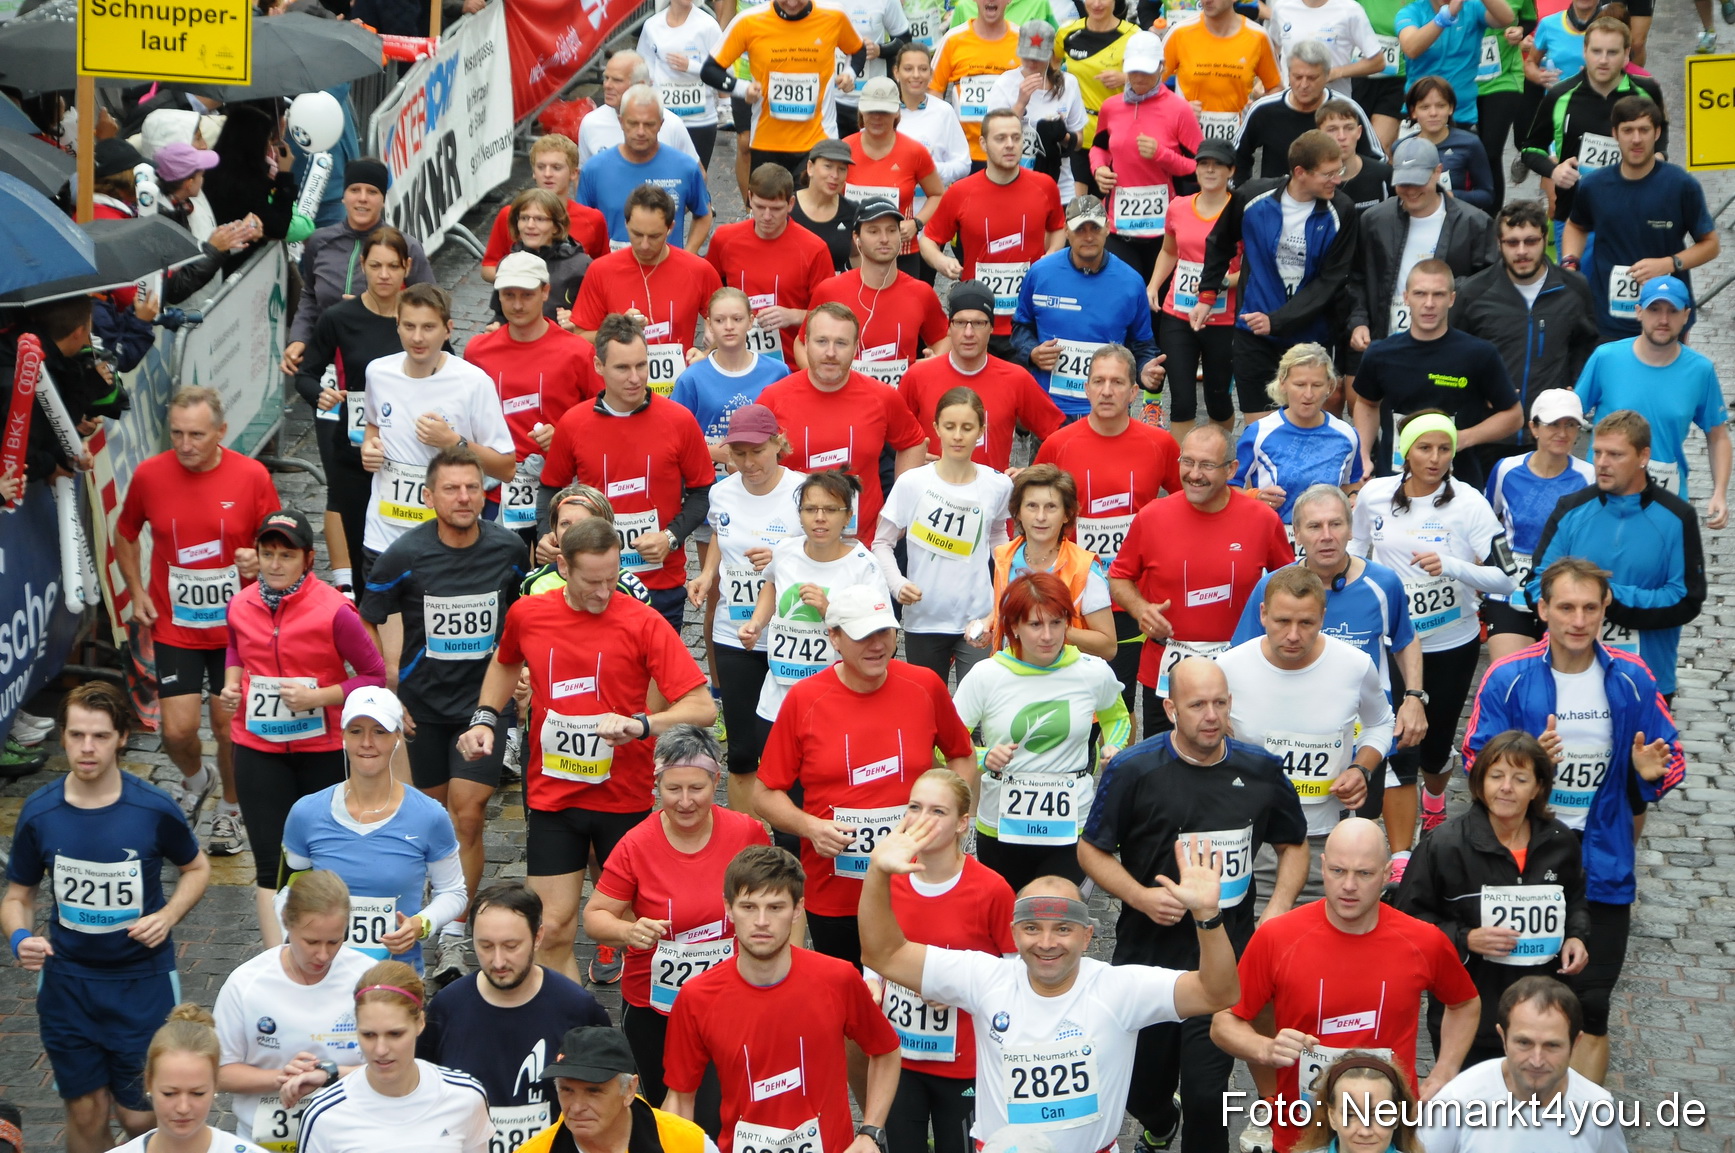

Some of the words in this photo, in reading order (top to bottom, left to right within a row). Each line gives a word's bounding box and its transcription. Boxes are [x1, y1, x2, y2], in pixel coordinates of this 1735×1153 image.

[90, 0, 237, 27] Schnupper-
[911, 21, 928, 37] 86
[141, 29, 188, 52] lauf
[1069, 48, 1088, 59] Birgit
[662, 88, 701, 105] 2860
[773, 84, 813, 102] 2981
[965, 86, 986, 104] 29
[778, 104, 808, 114] Christian
[1585, 147, 1622, 166] 248
[1120, 199, 1164, 216] 2223
[1128, 220, 1154, 229] Andrea
[994, 299, 1017, 308] ichael
[870, 348, 887, 358] DEHN
[649, 358, 675, 380] 09
[871, 365, 900, 373] Neumarkt
[1058, 353, 1091, 375] 248
[512, 399, 530, 409] DEHN
[6, 410, 28, 449] BKK
[819, 454, 837, 463] DEHN
[617, 482, 635, 492] DEHN
[925, 488, 945, 504] PARTL
[944, 499, 972, 513] Neumarkt
[1101, 498, 1120, 508] DEHN
[392, 506, 424, 520] Markus
[614, 517, 647, 527] Neumarkt
[928, 507, 966, 537] 411
[1078, 522, 1100, 532] PARTL
[1100, 522, 1132, 531] Neumark
[926, 531, 954, 551] Nicole
[171, 571, 193, 581] PARTL
[193, 571, 227, 582] Neumarkt
[726, 569, 743, 577] PARTL
[1415, 577, 1447, 590] Neumarkt
[177, 582, 235, 606] 2006
[1199, 590, 1219, 601] DEHN
[425, 602, 450, 610] PARTL
[451, 600, 487, 610] Neumarkt
[192, 610, 219, 621] Josef
[432, 609, 492, 636] 2589
[770, 622, 788, 632] PARTL
[788, 627, 821, 635] Neumarkt
[1414, 614, 1446, 631] Kerstin
[444, 641, 481, 651] Norbert
[773, 633, 828, 662] 2742
[780, 665, 817, 678] Cornelia
[250, 682, 269, 690] PARTL
[565, 681, 585, 693] DEHN
[261, 721, 309, 735] Sieglinde
[546, 717, 565, 730] PARTL
[566, 722, 599, 731] Neumark
[555, 730, 601, 758] 207
[1266, 738, 1293, 748] PARTL
[1294, 740, 1332, 749] Neumarkt
[1567, 750, 1604, 760] Neumarkt
[559, 758, 599, 774] Michael
[1282, 750, 1330, 777] 442
[865, 764, 887, 777] DEHN
[1559, 761, 1607, 788] 452
[1003, 778, 1029, 787] PARTL
[1029, 780, 1064, 788] Neumarkt
[1295, 783, 1321, 795] effen
[1007, 789, 1071, 817] 2746
[1554, 793, 1590, 805] Hubert
[835, 814, 862, 824] PARTL
[864, 813, 901, 824] Neumarkt
[1026, 824, 1048, 835] Inka
[1211, 837, 1247, 847] Neumarkt
[56, 863, 82, 875] PARTL
[84, 868, 126, 878] Neumarkt
[63, 876, 134, 906] 2215
[1483, 893, 1513, 902] PARTL
[1514, 893, 1552, 902] Neumarkt
[78, 911, 115, 924] Stefan
[1491, 905, 1558, 934] 2506
[688, 927, 710, 940] DEHN
[657, 945, 681, 958] PARTL
[681, 947, 720, 959] Neumarkt
[1509, 942, 1545, 954] arbara
[659, 959, 725, 987] 227
[887, 980, 905, 994] PARTL
[887, 994, 949, 1032] 2319
[1336, 1017, 1361, 1029] DEHN
[256, 1035, 280, 1045] PARTL
[1003, 1053, 1031, 1063] PARTL
[1033, 1050, 1079, 1062] Neumarkt
[1302, 1050, 1330, 1063] PARTL
[765, 1078, 787, 1092] DEHN
[1011, 1060, 1090, 1099] 2825
[260, 1096, 279, 1105] PART
[1041, 1105, 1066, 1120] Can
[736, 1129, 763, 1143] PARTL
[764, 1132, 805, 1146] Neumarkt
